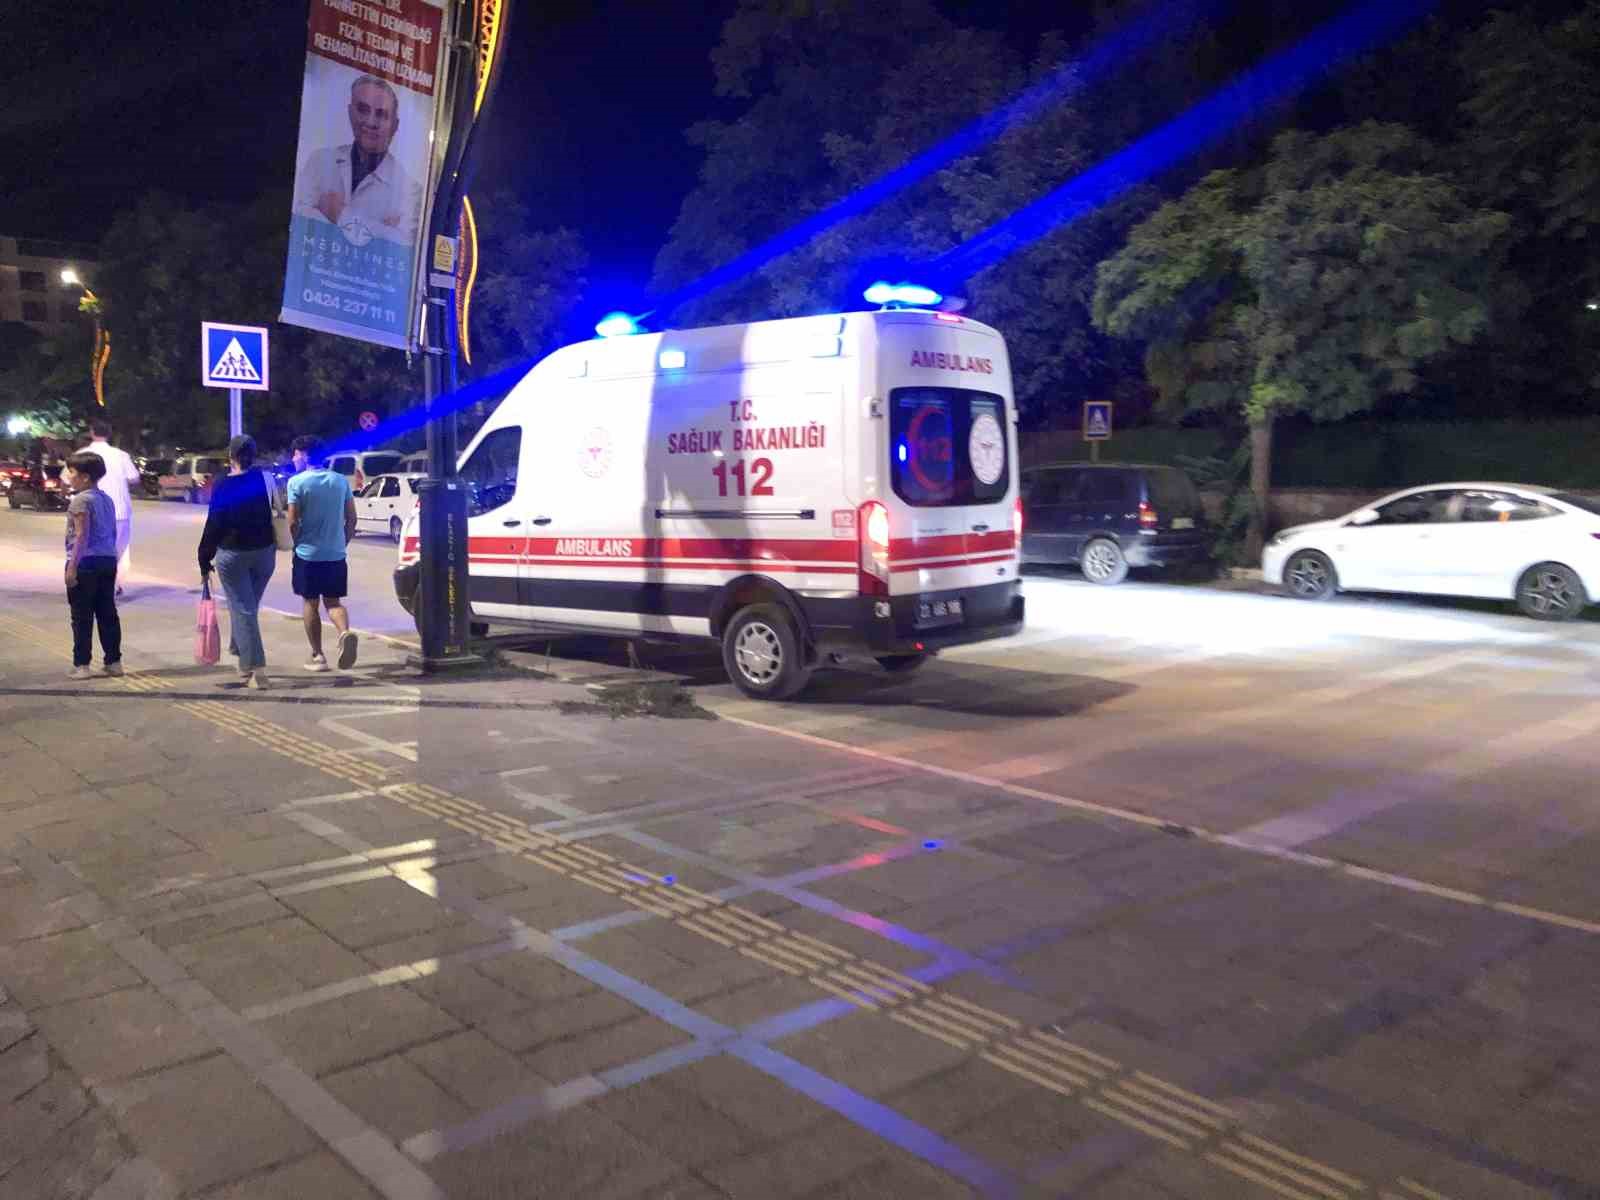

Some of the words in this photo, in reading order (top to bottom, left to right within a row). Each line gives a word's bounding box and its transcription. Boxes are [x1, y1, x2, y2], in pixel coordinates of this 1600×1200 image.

[303, 288, 340, 309] 0424
[343, 298, 368, 316] 237
[911, 349, 993, 375] AMBULANS
[729, 399, 758, 423] T.C.
[667, 428, 722, 455] SAĞLIK
[733, 421, 825, 451] BAKANLIĞI
[712, 457, 774, 497] 112
[555, 538, 632, 557] AMBULANS
